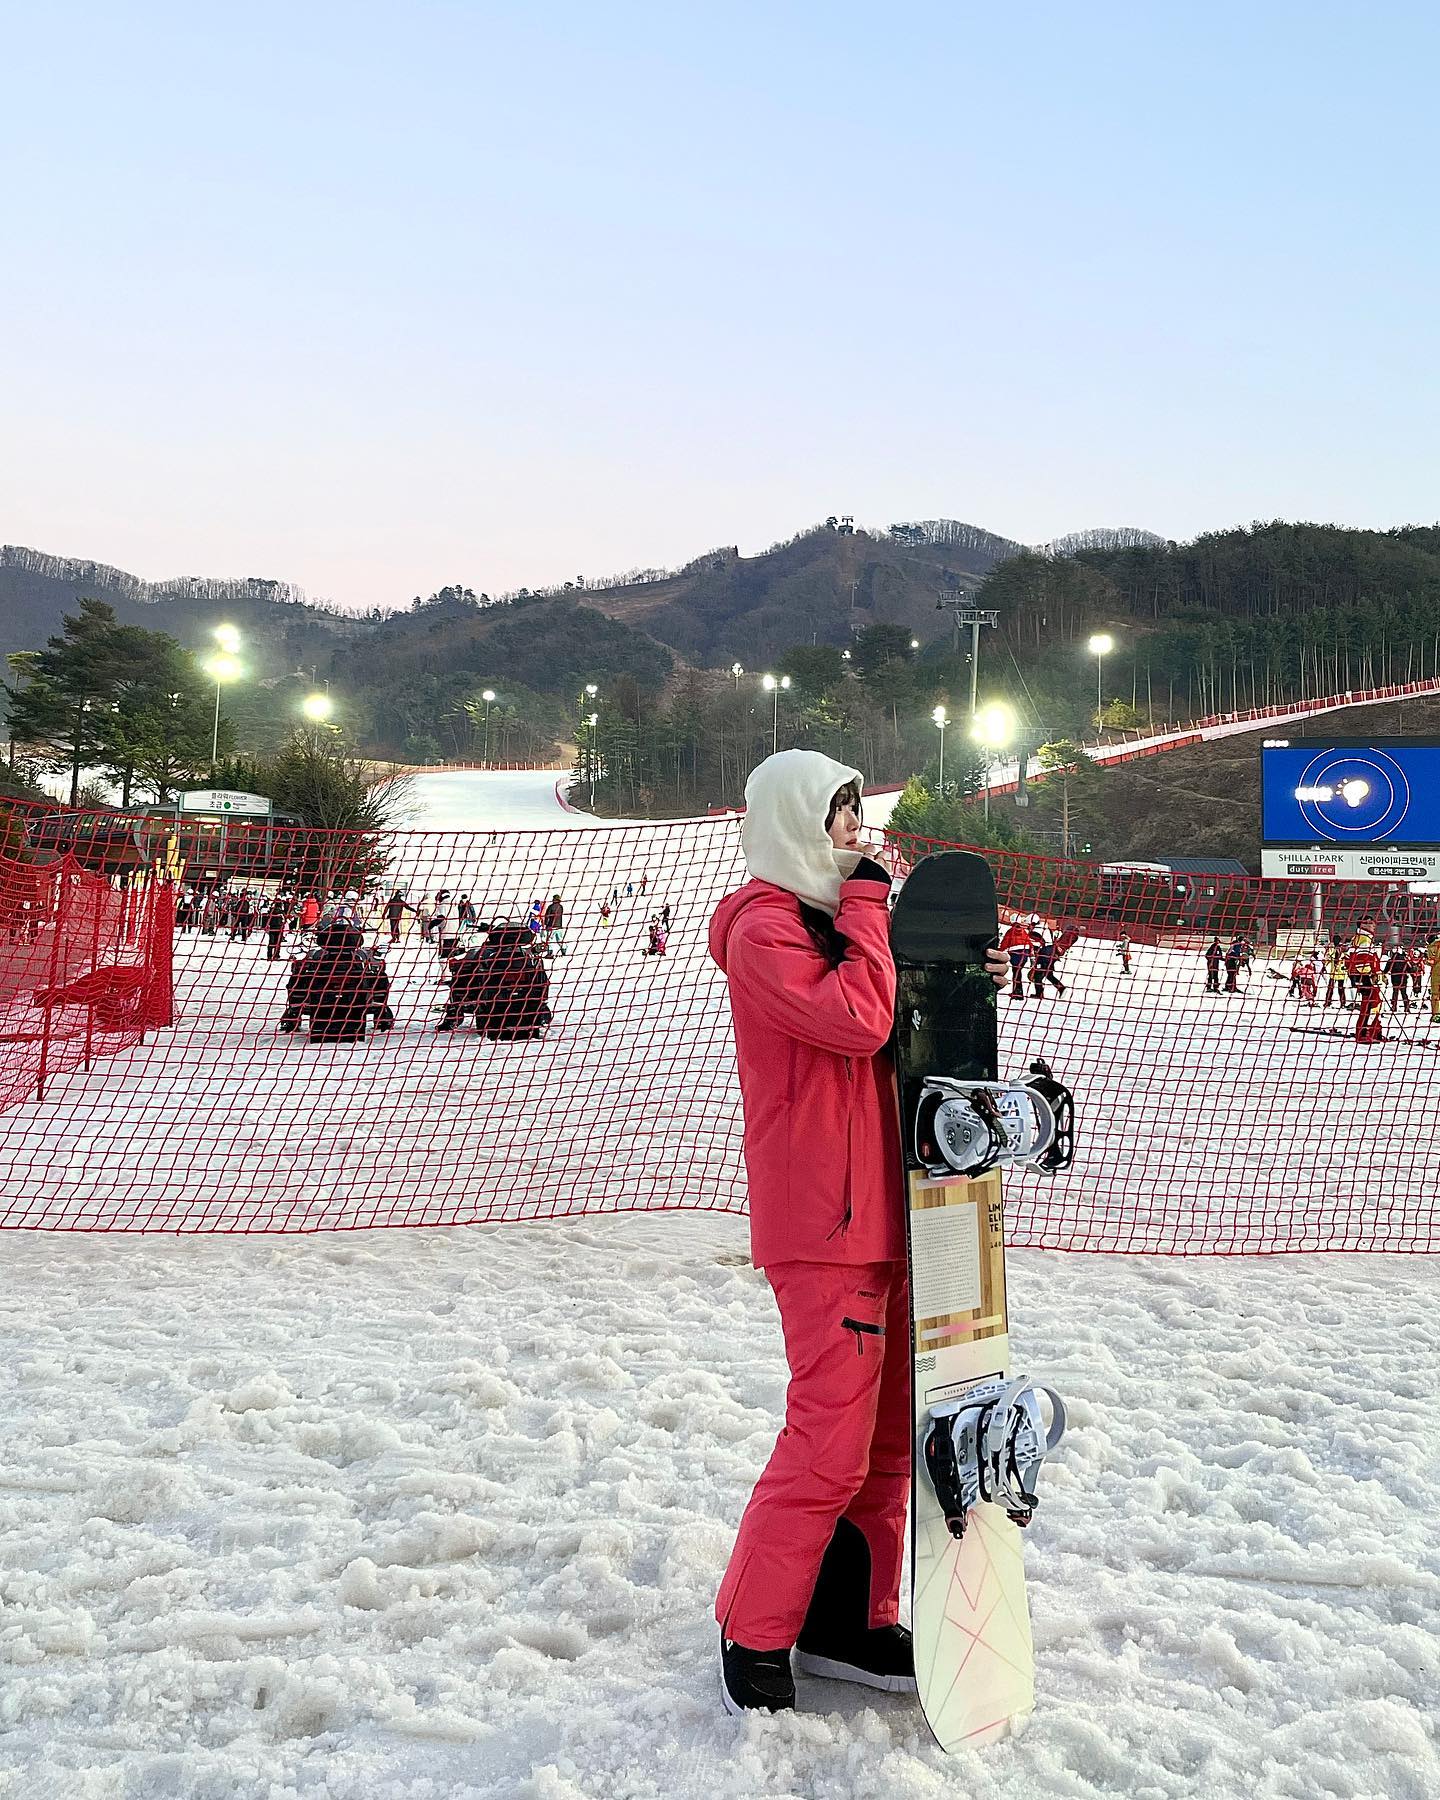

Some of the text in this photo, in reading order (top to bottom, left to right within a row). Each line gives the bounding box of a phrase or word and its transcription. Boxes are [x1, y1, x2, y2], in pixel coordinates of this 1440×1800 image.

[1278, 853, 1311, 862] SHILLA
[1289, 865, 1333, 874] duty free
[988, 1203, 1001, 1212] LIM
